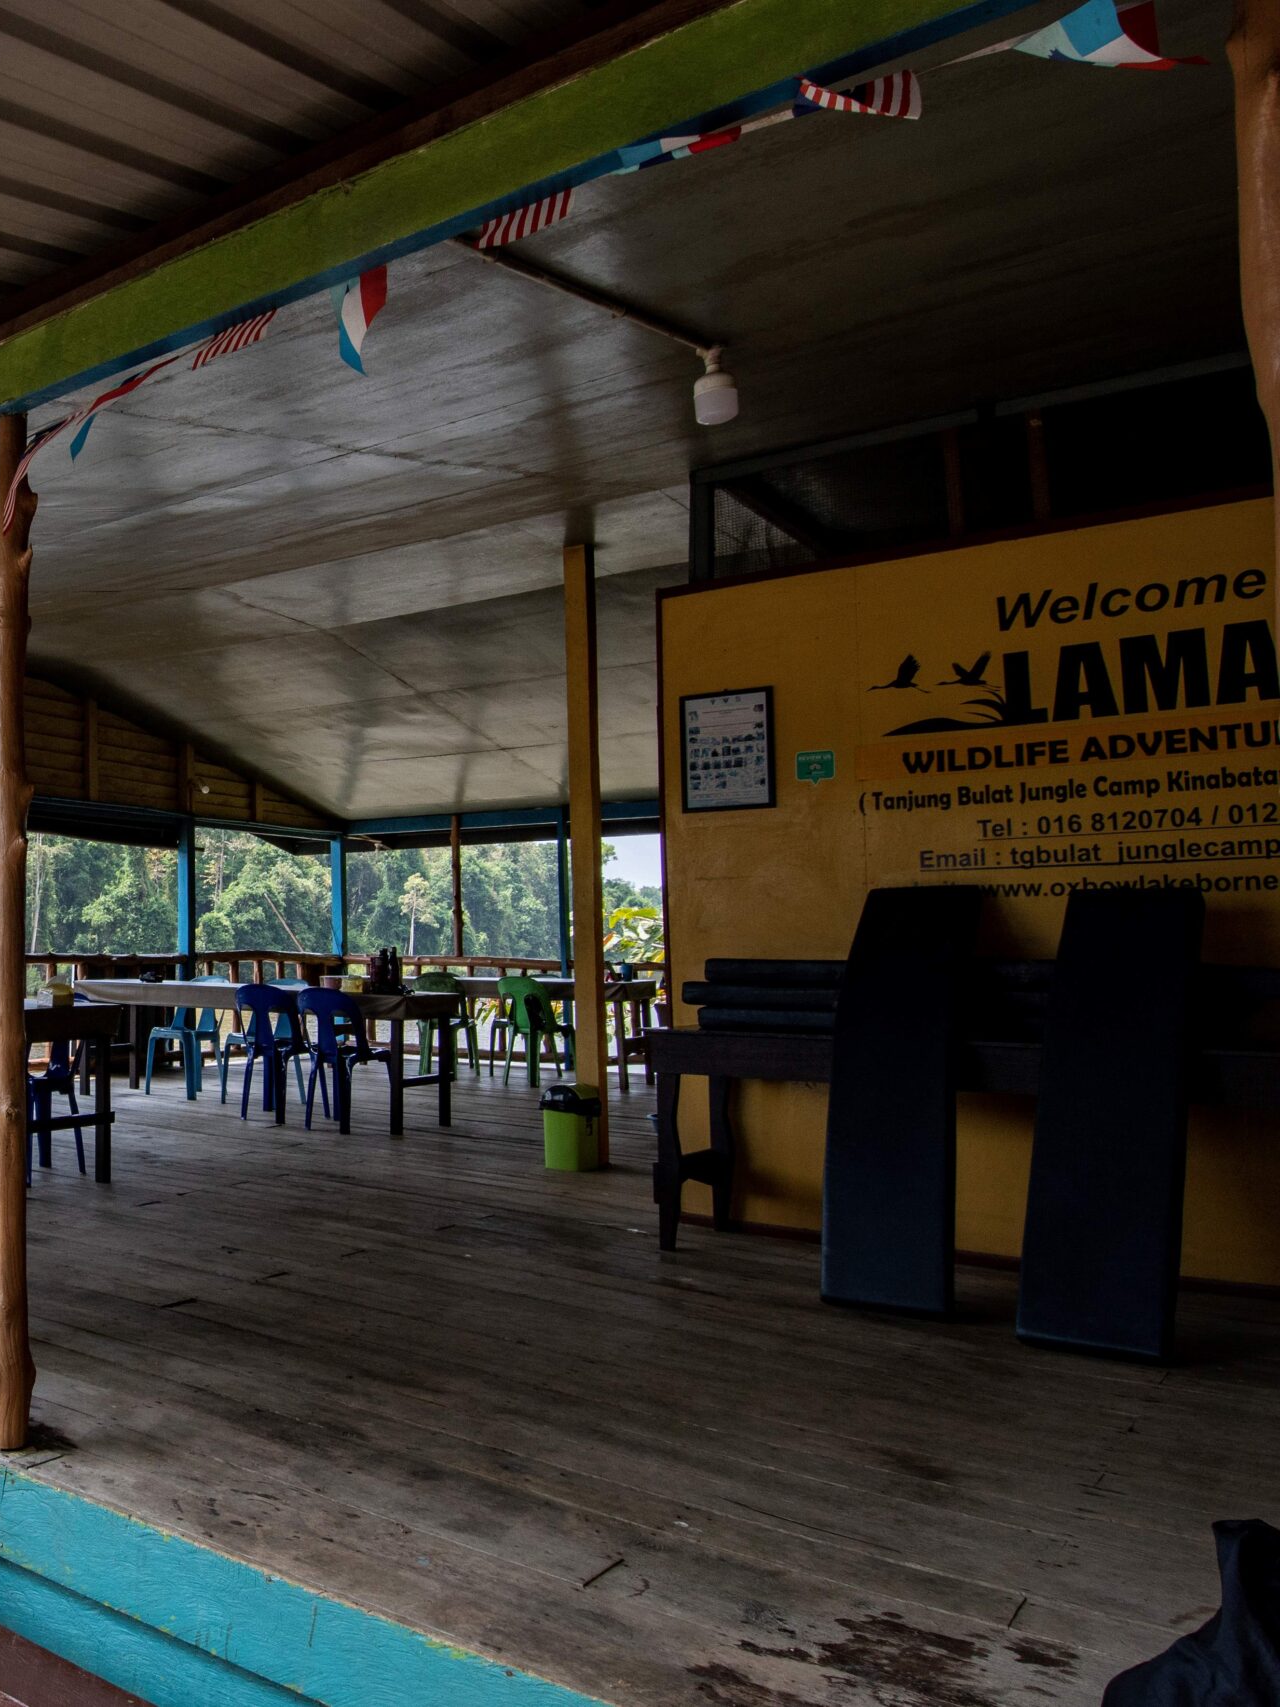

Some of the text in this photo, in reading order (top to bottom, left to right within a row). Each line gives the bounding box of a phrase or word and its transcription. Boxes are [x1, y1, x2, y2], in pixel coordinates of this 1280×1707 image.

[997, 569, 1266, 631] Welcome
[1003, 619, 1280, 723] LAMA
[902, 739, 1069, 774] WILDLIFE
[872, 791, 951, 811] Tanjung
[957, 784, 1013, 805] Bulat
[1019, 778, 1086, 804] Jungle
[1093, 775, 1160, 798] Camp
[1167, 766, 1280, 792] Kinabata
[977, 818, 1012, 838] Tel
[1037, 814, 1082, 835] 016
[1091, 806, 1202, 832] 8120704
[1228, 803, 1278, 825] 012
[920, 848, 986, 868] Email
